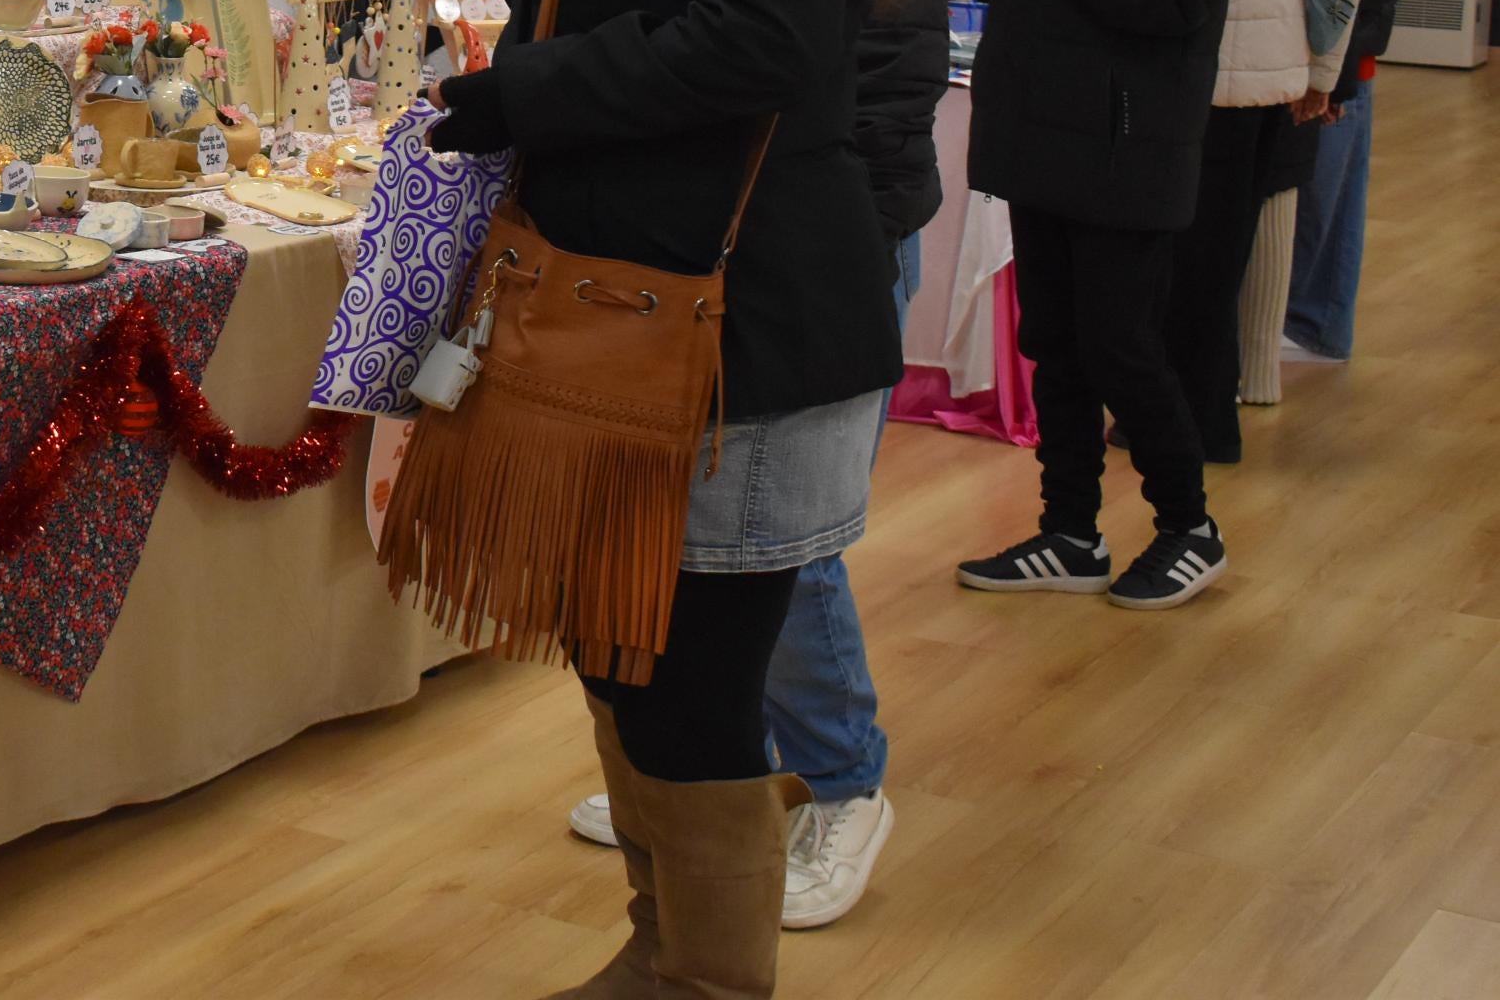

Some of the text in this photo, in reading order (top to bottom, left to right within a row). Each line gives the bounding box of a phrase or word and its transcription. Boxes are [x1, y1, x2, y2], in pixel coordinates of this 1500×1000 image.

[54, 2, 70, 12] 24€
[77, 136, 97, 148] Jarrita
[81, 154, 94, 165] 15€
[206, 153, 221, 166] 25€
